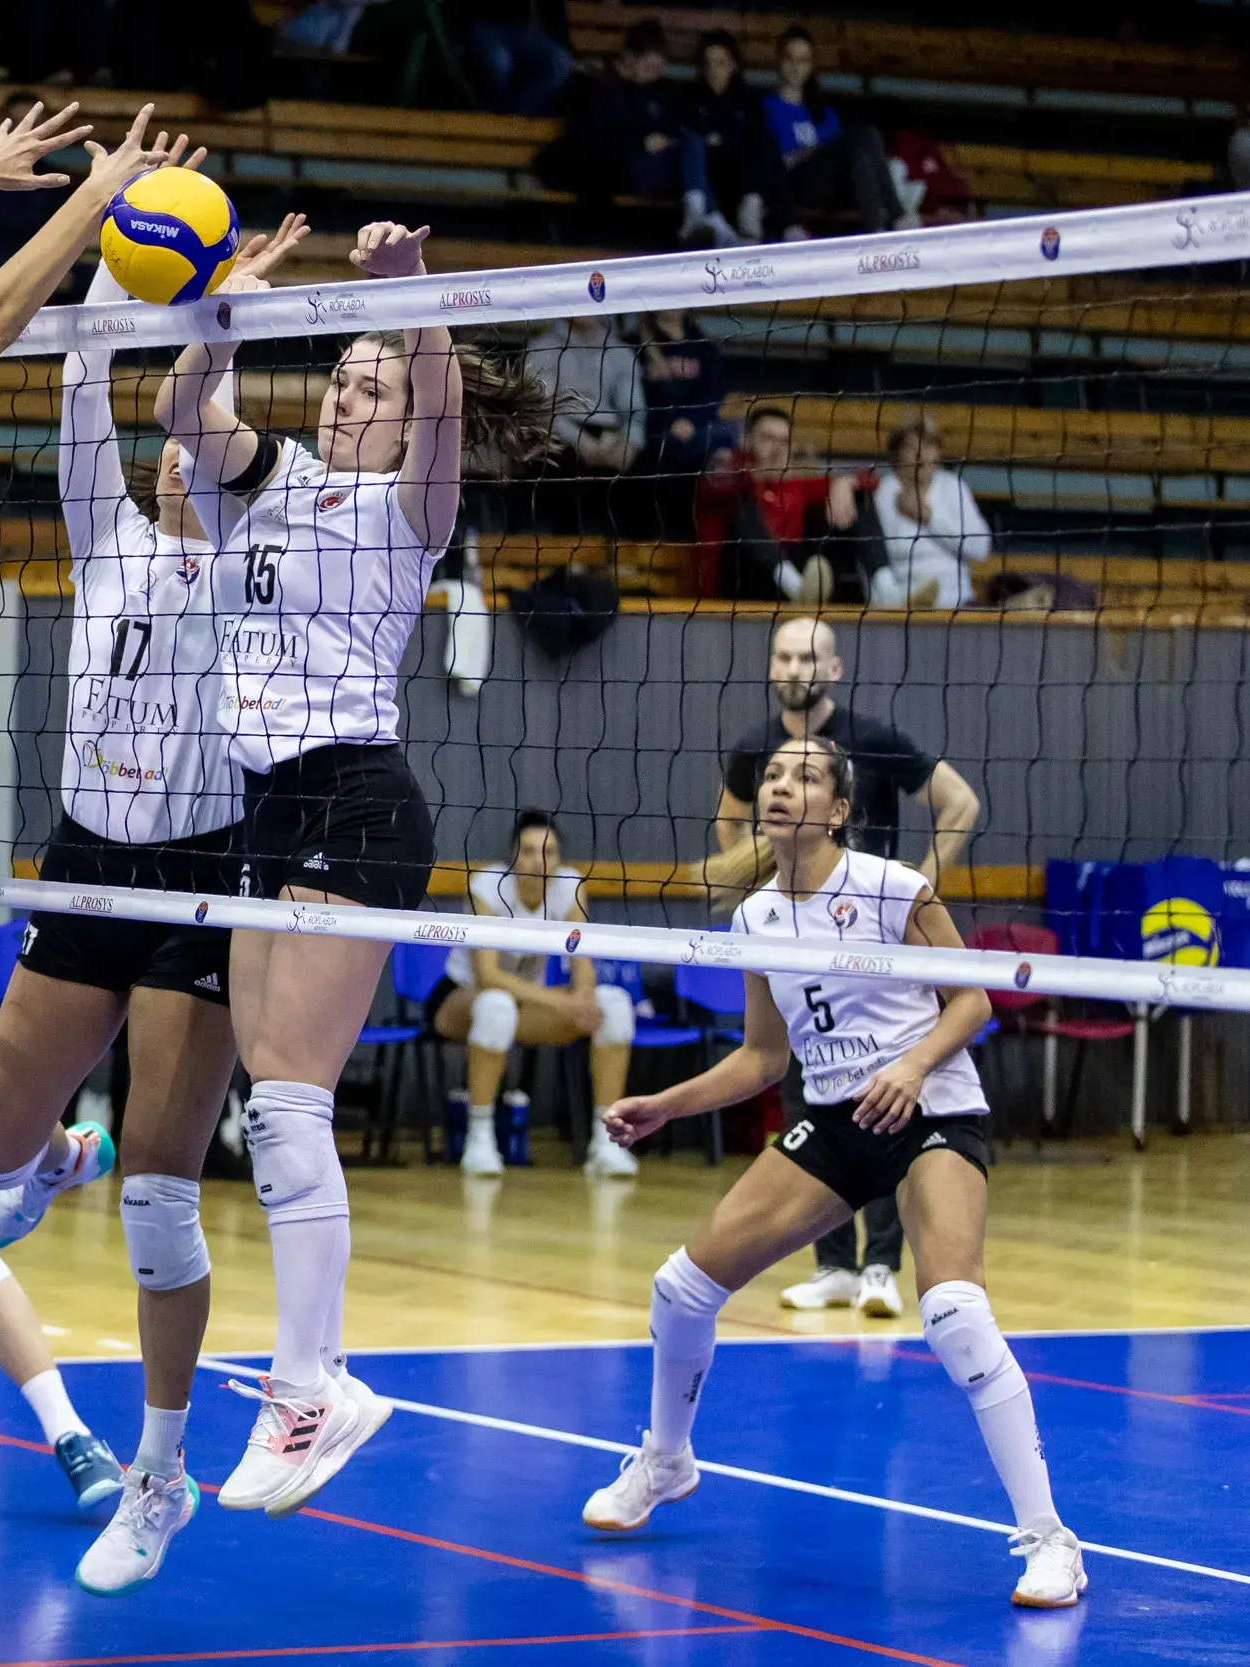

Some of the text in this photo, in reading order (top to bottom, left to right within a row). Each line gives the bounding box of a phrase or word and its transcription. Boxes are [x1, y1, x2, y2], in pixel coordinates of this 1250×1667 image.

[130, 219, 180, 238] MIKASA
[856, 250, 921, 274] ALPROSYS
[438, 289, 492, 309] ALPROSYS
[91, 317, 136, 335] ALPROSYS
[243, 544, 283, 604] 15
[110, 619, 152, 681] 17
[220, 620, 300, 659] FATUM
[83, 677, 179, 727] FATUM
[69, 895, 114, 913] ALPROSYS
[413, 924, 469, 942] ALPROSYS
[829, 952, 894, 974] ALPROSYS
[194, 979, 221, 992] adidas
[803, 984, 835, 1033] 5
[803, 1033, 880, 1067] FATUM
[783, 1119, 815, 1151] 5
